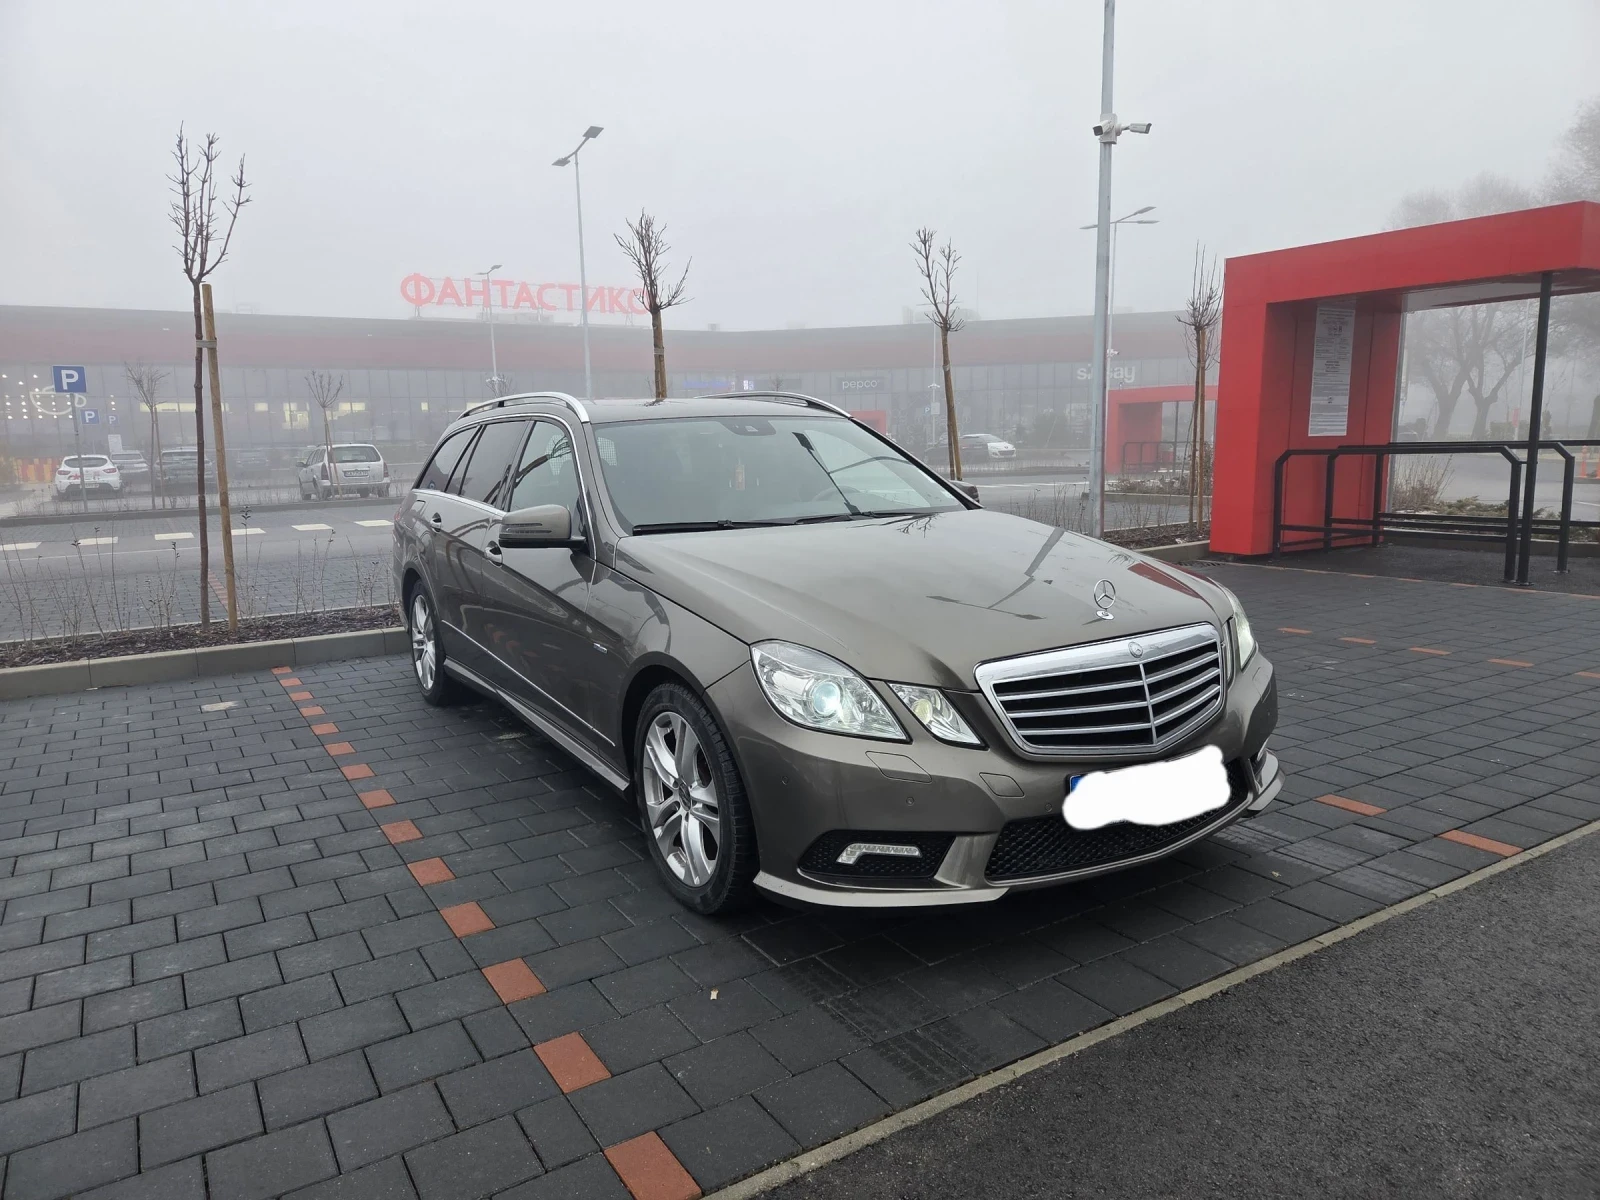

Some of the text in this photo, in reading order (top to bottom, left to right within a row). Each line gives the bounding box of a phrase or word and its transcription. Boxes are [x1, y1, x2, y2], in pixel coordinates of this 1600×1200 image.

[61, 370, 78, 390] P
[842, 379, 878, 390] pepco
[85, 411, 95, 422] P
[109, 415, 116, 424] P
